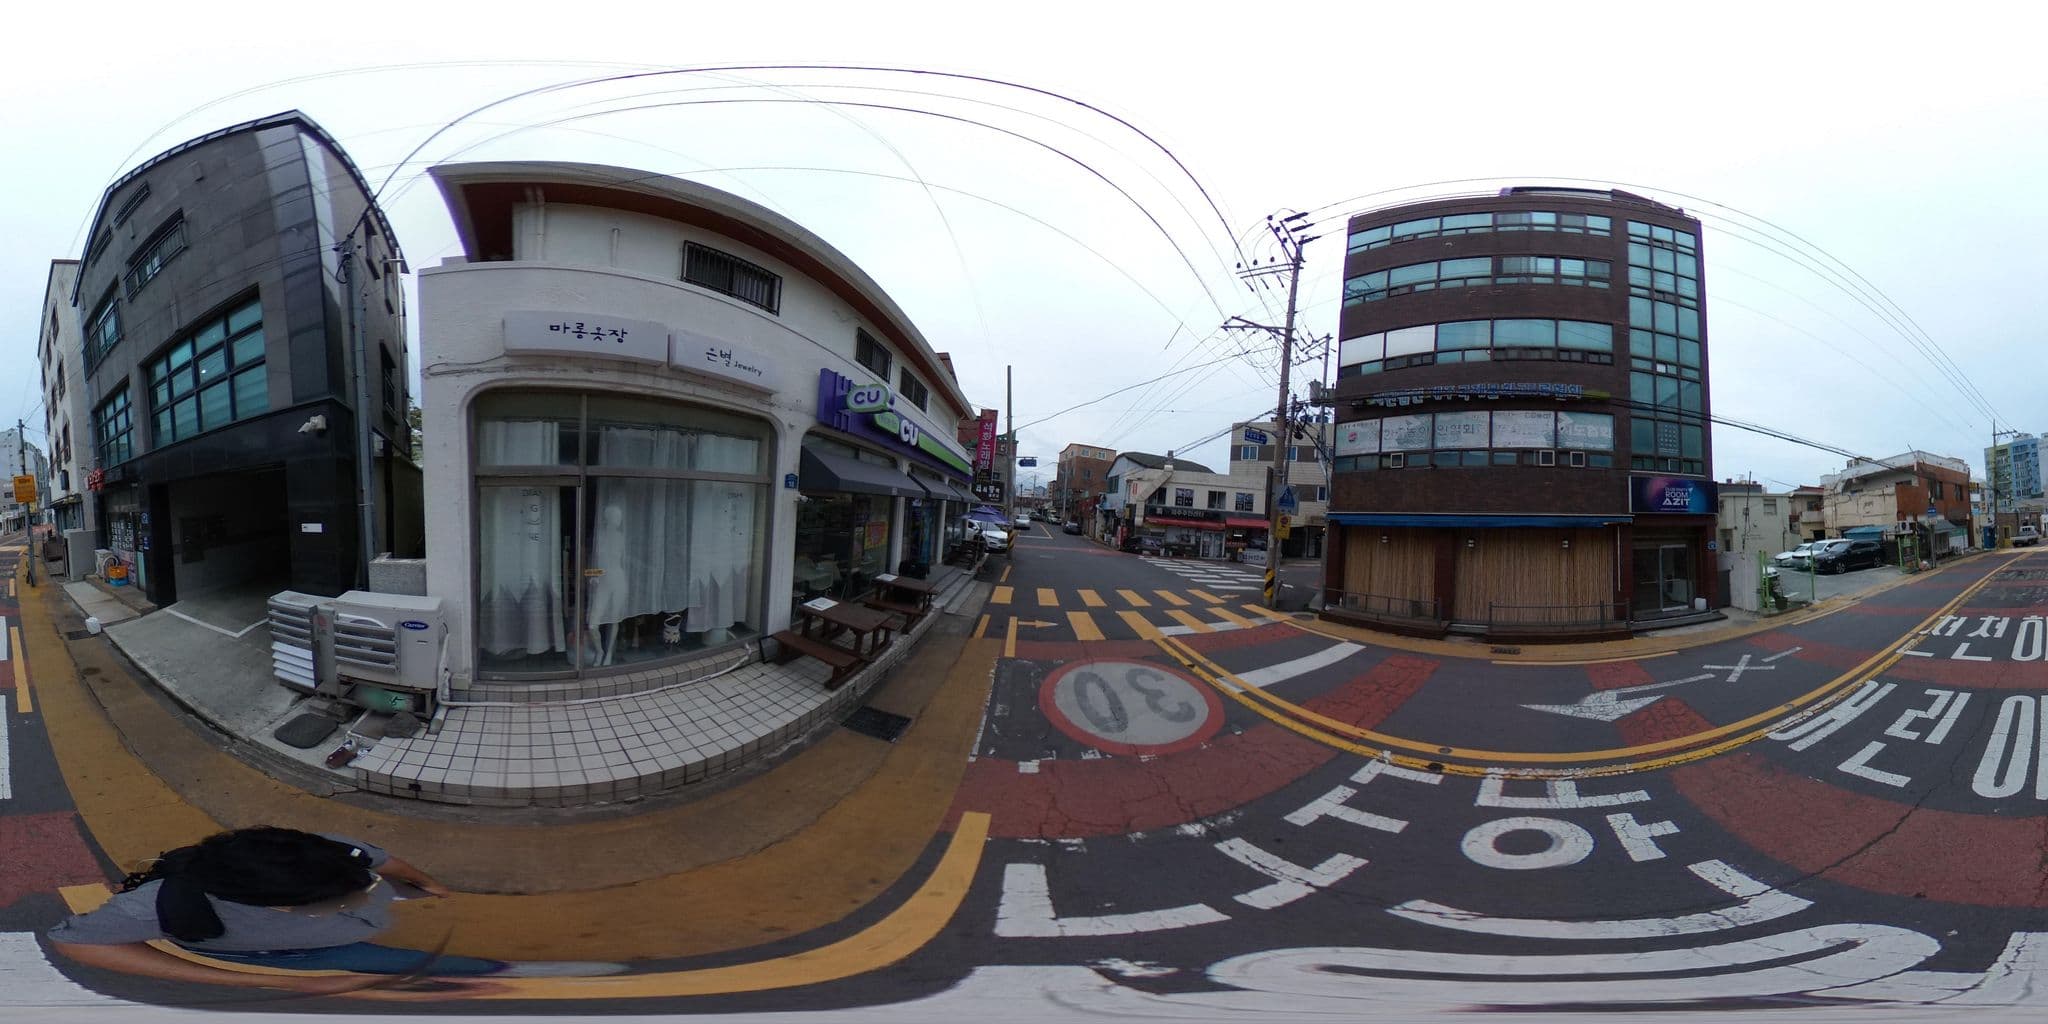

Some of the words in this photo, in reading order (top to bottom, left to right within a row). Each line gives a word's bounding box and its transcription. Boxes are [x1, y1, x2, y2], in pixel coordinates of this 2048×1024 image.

[549, 321, 628, 344] 마롱옷장
[705, 346, 732, 367] 은별
[853, 390, 880, 405] CU
[900, 420, 918, 446] CU
[1073, 667, 1197, 734] 30
